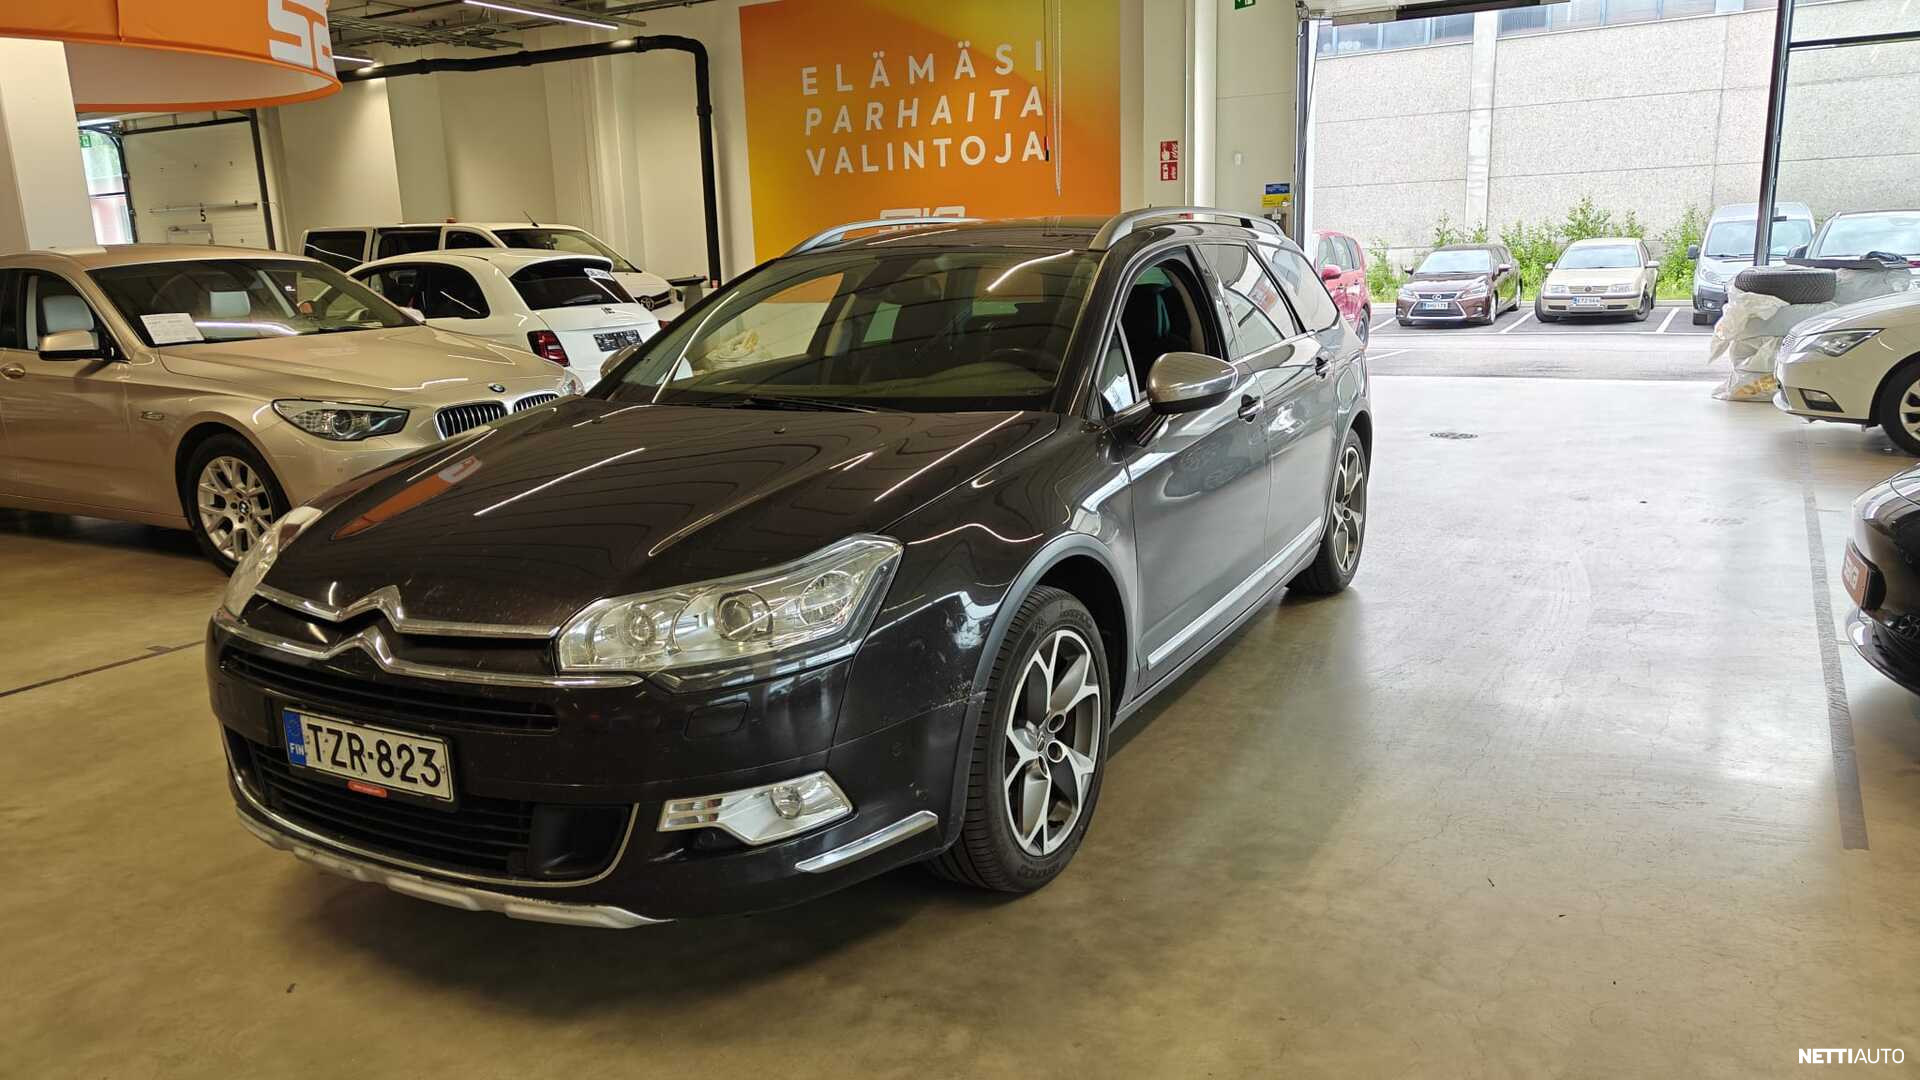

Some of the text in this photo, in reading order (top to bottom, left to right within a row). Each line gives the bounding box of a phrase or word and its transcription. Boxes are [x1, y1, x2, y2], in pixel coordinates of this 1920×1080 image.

[801, 40, 1043, 95] ELÄMÄSI
[805, 86, 1043, 136] PARHAITA
[805, 131, 1045, 176] VALINTOJA
[290, 742, 305, 755] FIN
[307, 723, 441, 788] TZR-823
